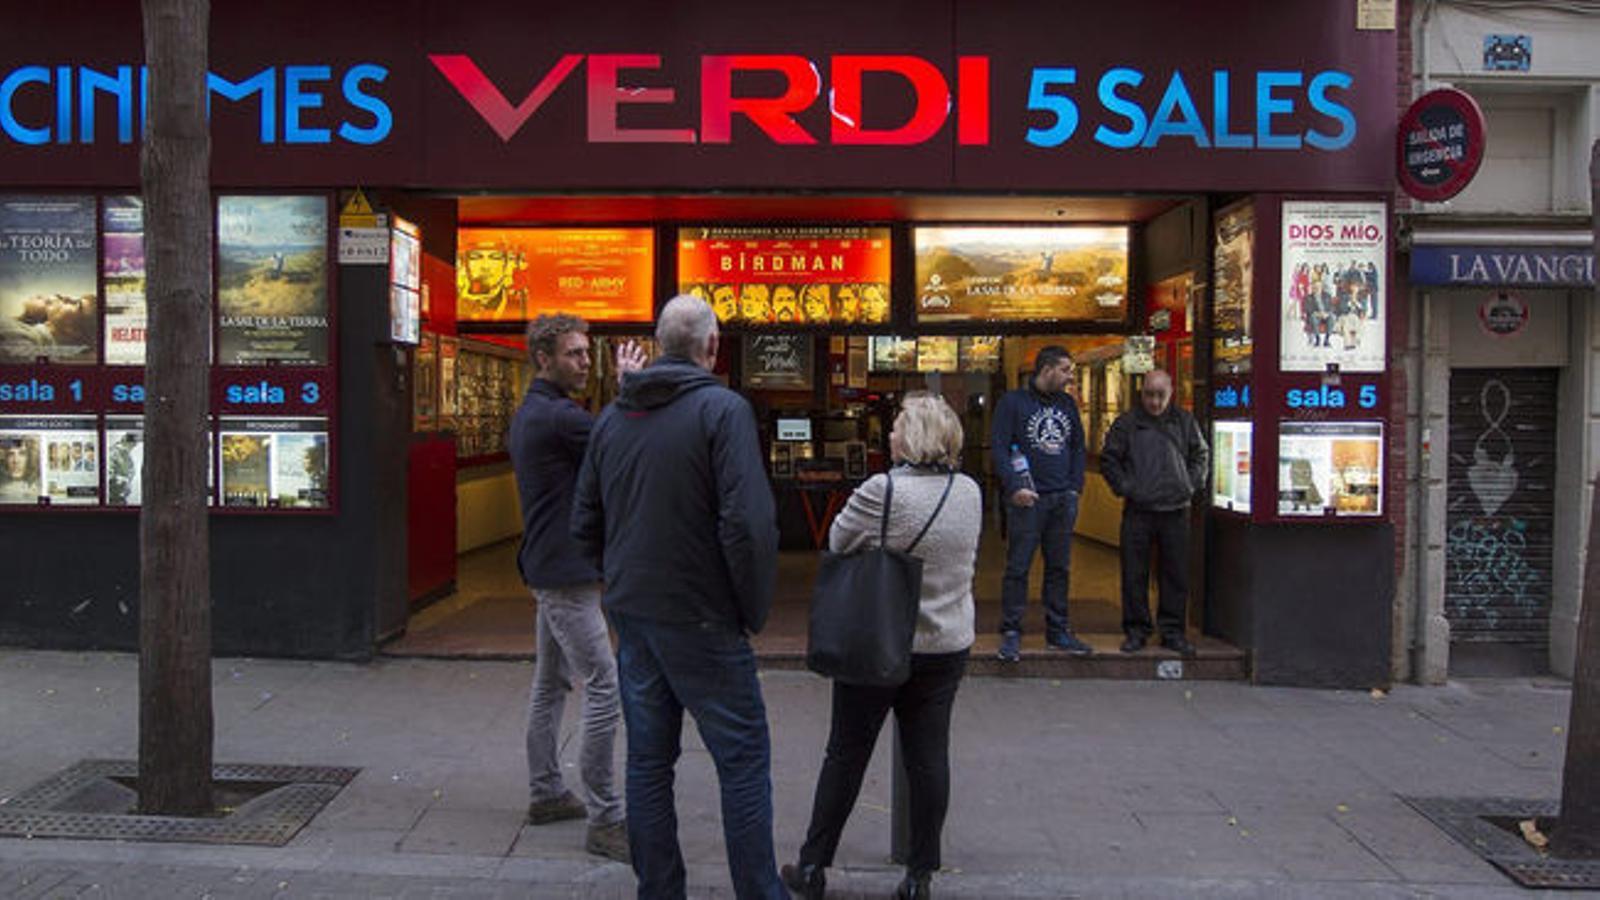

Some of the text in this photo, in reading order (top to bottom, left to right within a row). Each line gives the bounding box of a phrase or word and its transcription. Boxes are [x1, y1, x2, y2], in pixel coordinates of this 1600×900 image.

[0, 53, 1357, 150] CINMES VERDI 5 SALES
[1408, 124, 1464, 145] SALIDA DE
[10, 232, 73, 249] TEORÍA
[1289, 224, 1335, 240] DIOS
[18, 250, 69, 262] TODO
[1451, 254, 1490, 282] LA
[558, 276, 627, 288] RED ARMY
[111, 326, 148, 343] RELAT
[0, 379, 82, 402] sala 1
[113, 384, 145, 401] sa
[227, 381, 319, 404] sala 3
[1286, 384, 1377, 408] sala 5
